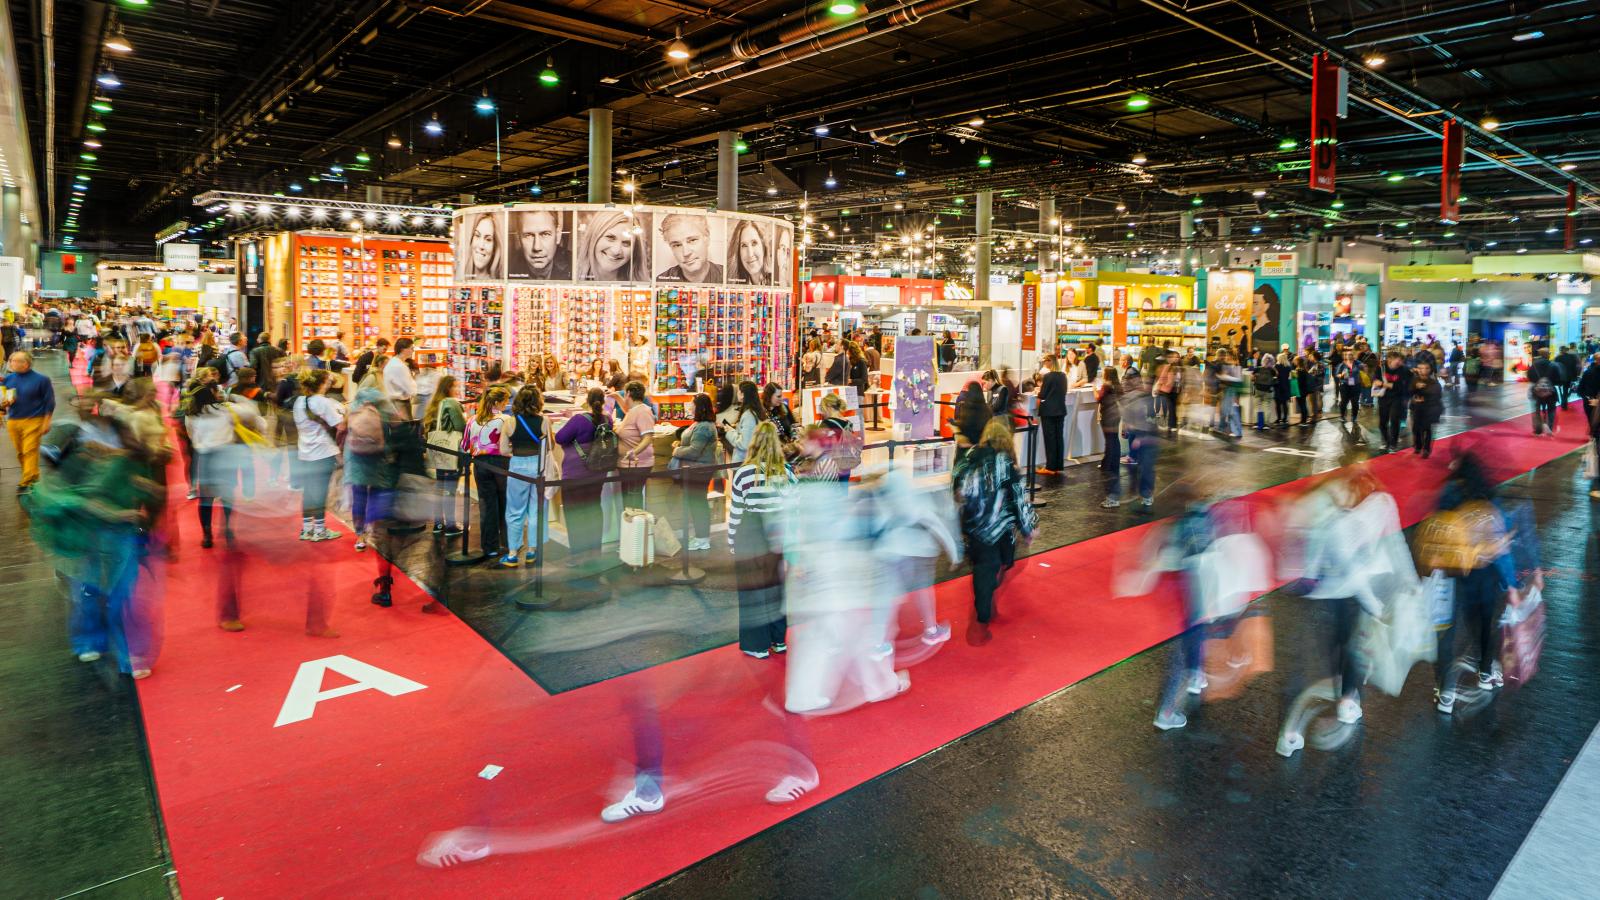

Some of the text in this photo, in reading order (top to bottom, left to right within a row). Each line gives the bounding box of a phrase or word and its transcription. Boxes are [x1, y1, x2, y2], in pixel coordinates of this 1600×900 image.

[1025, 287, 1034, 336] Information
[1117, 290, 1125, 314] Kasse
[273, 654, 429, 728] A
